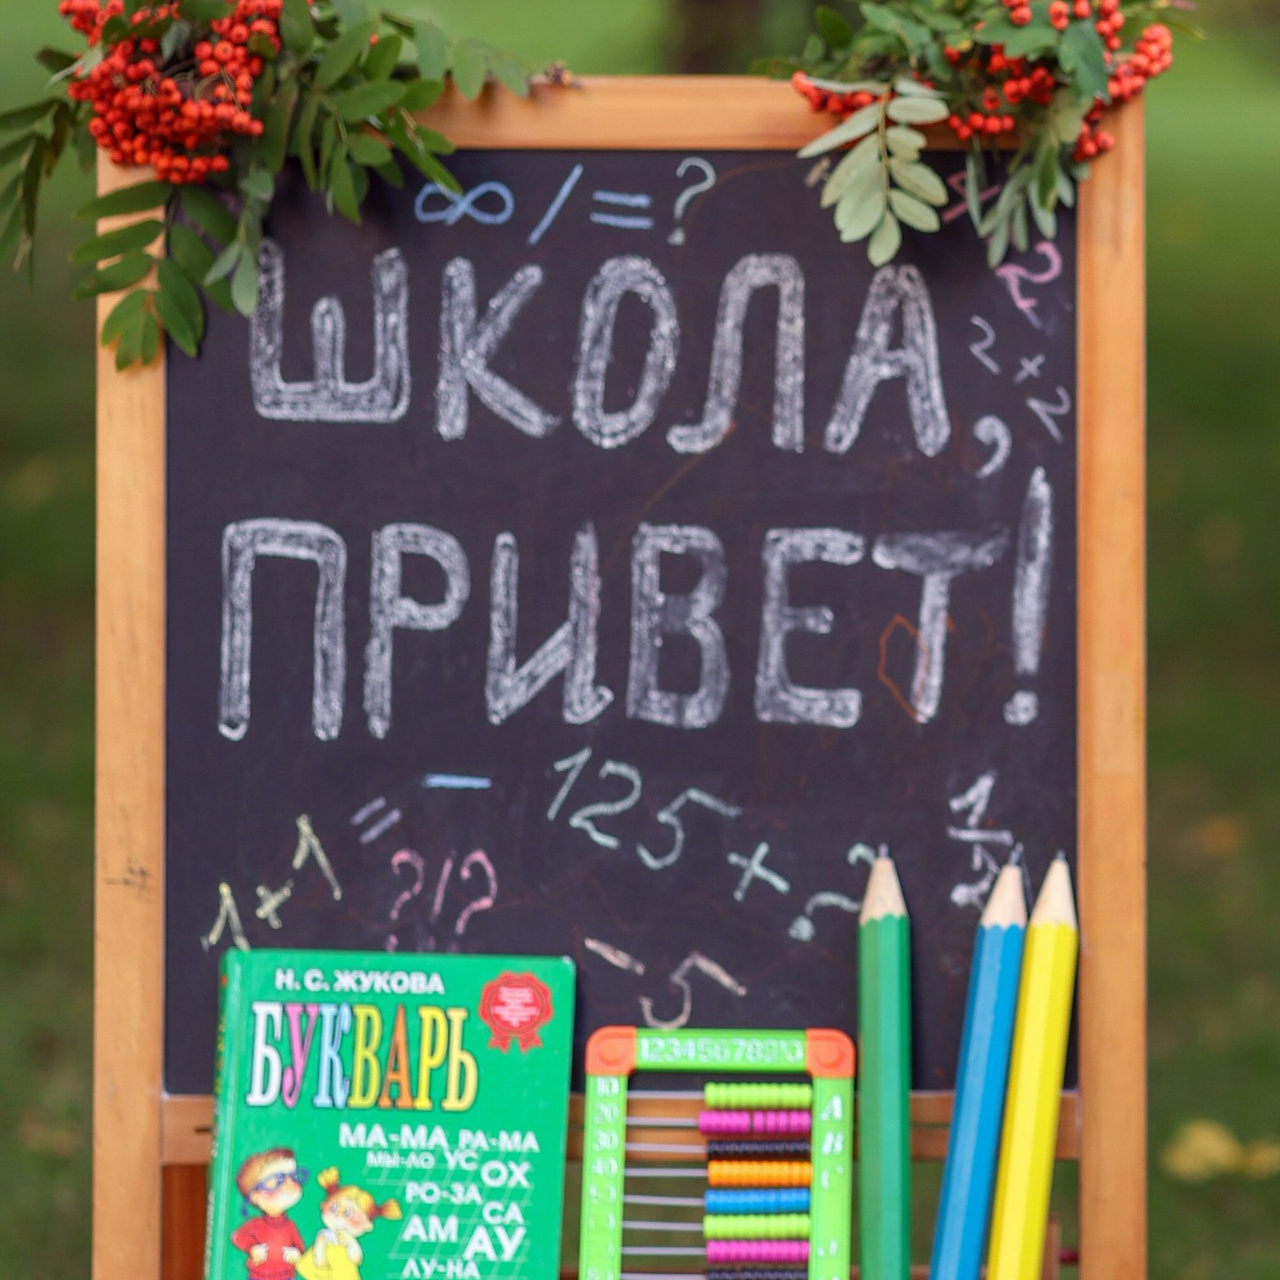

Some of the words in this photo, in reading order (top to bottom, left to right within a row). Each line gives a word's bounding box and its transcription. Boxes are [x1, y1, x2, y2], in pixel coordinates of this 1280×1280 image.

[249, 237, 1011, 478] ШКОЛА,
[218, 465, 1053, 741] ПРИВЕТ!
[549, 746, 741, 870] 125
[274, 968, 300, 991] Н.
[303, 968, 331, 992] С.
[333, 969, 446, 996] ЖУКОВА
[246, 1001, 480, 1113] БУКВАРЬ
[338, 1122, 450, 1150] МА-МА
[458, 1129, 541, 1153] РА-МА
[366, 1150, 436, 1170] МЫ-ЛО
[445, 1149, 480, 1172] УС
[480, 1160, 532, 1189] ОХ
[405, 1182, 483, 1205] РО-ЗА
[402, 1215, 459, 1243] АМ
[482, 1201, 525, 1226] СА
[463, 1226, 528, 1262] АУ
[402, 1257, 482, 1280] ЛУ-НА
